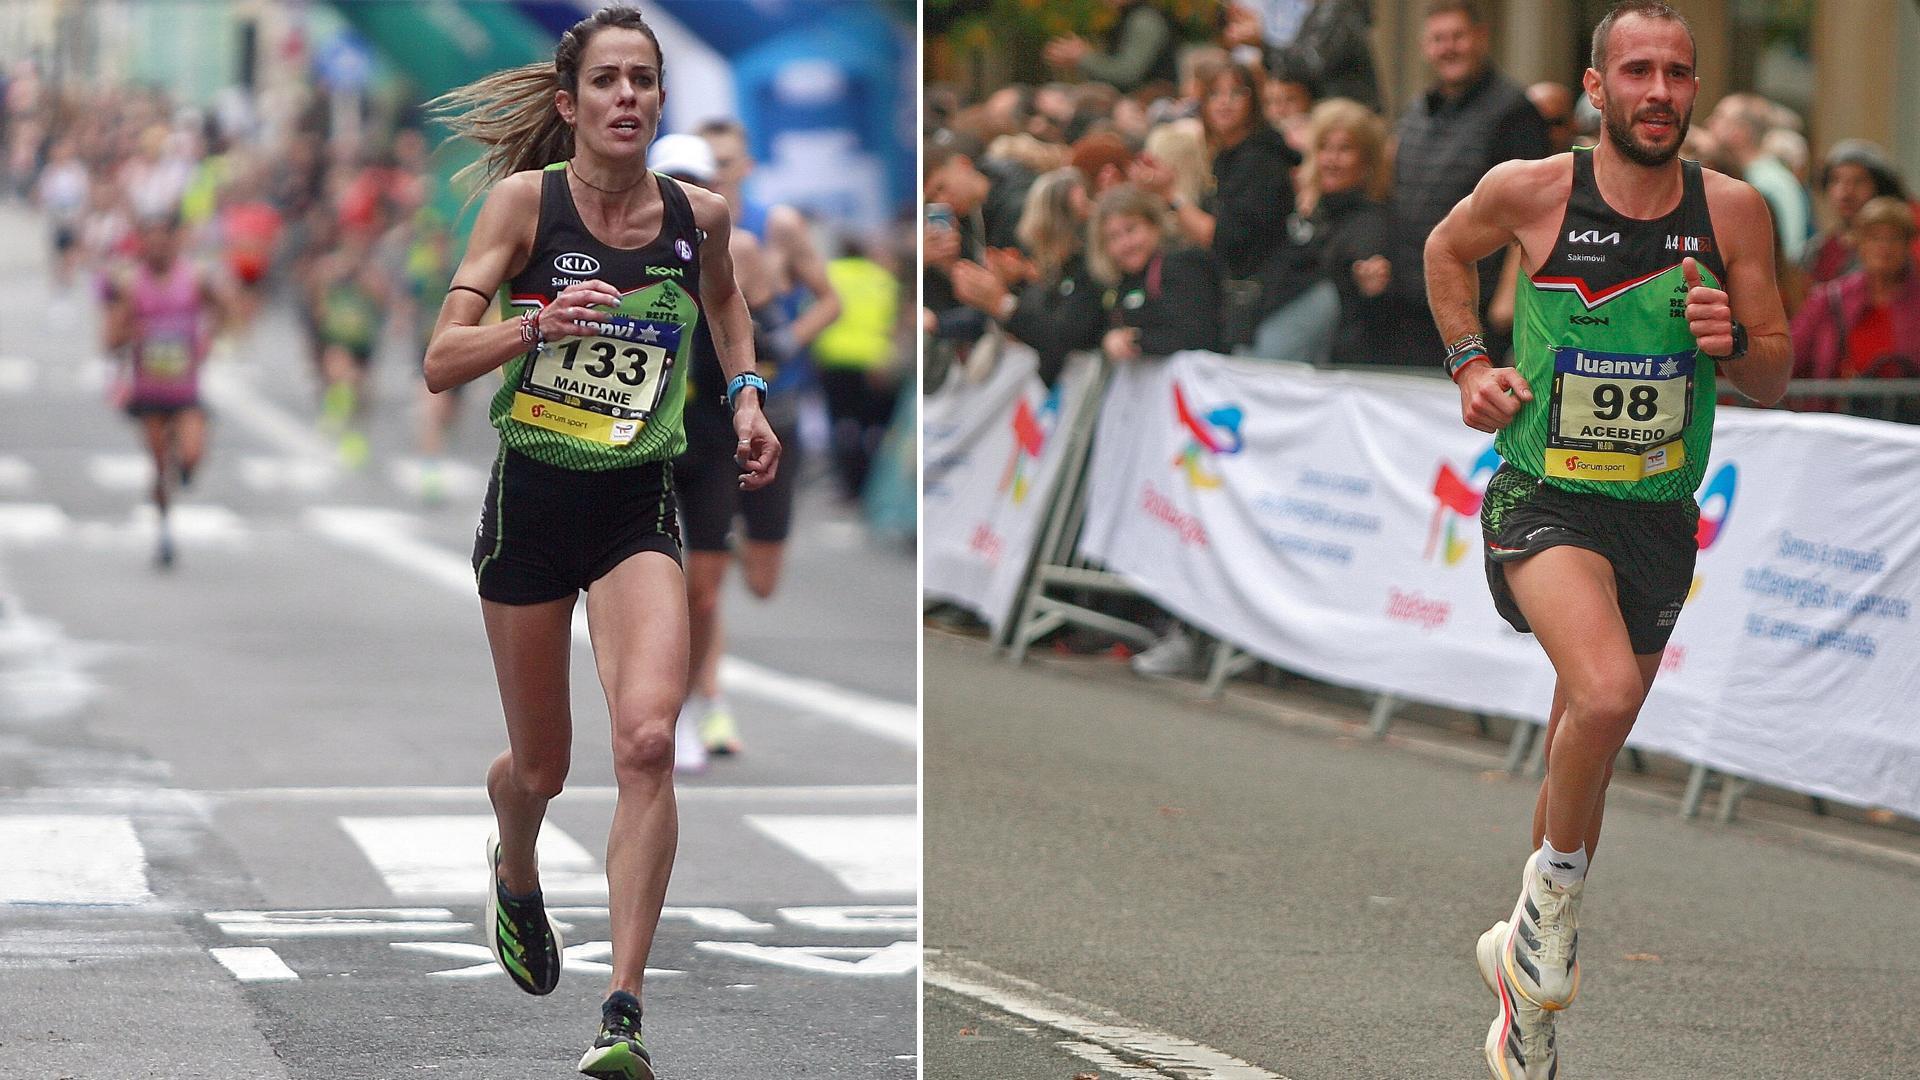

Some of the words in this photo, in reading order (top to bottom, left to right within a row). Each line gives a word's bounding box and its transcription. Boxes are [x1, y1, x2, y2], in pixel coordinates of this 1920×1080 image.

[1569, 230, 1620, 245] KIA
[561, 257, 593, 270] KIA
[1567, 253, 1606, 263] Sakimóvil
[557, 338, 649, 387] 133
[1575, 352, 1653, 376] luanvi
[553, 375, 632, 406] MAITANE
[1592, 383, 1659, 422] 98
[567, 416, 588, 429] sport
[1580, 425, 1666, 442] ACEBEDO
[1604, 463, 1625, 472] sport
